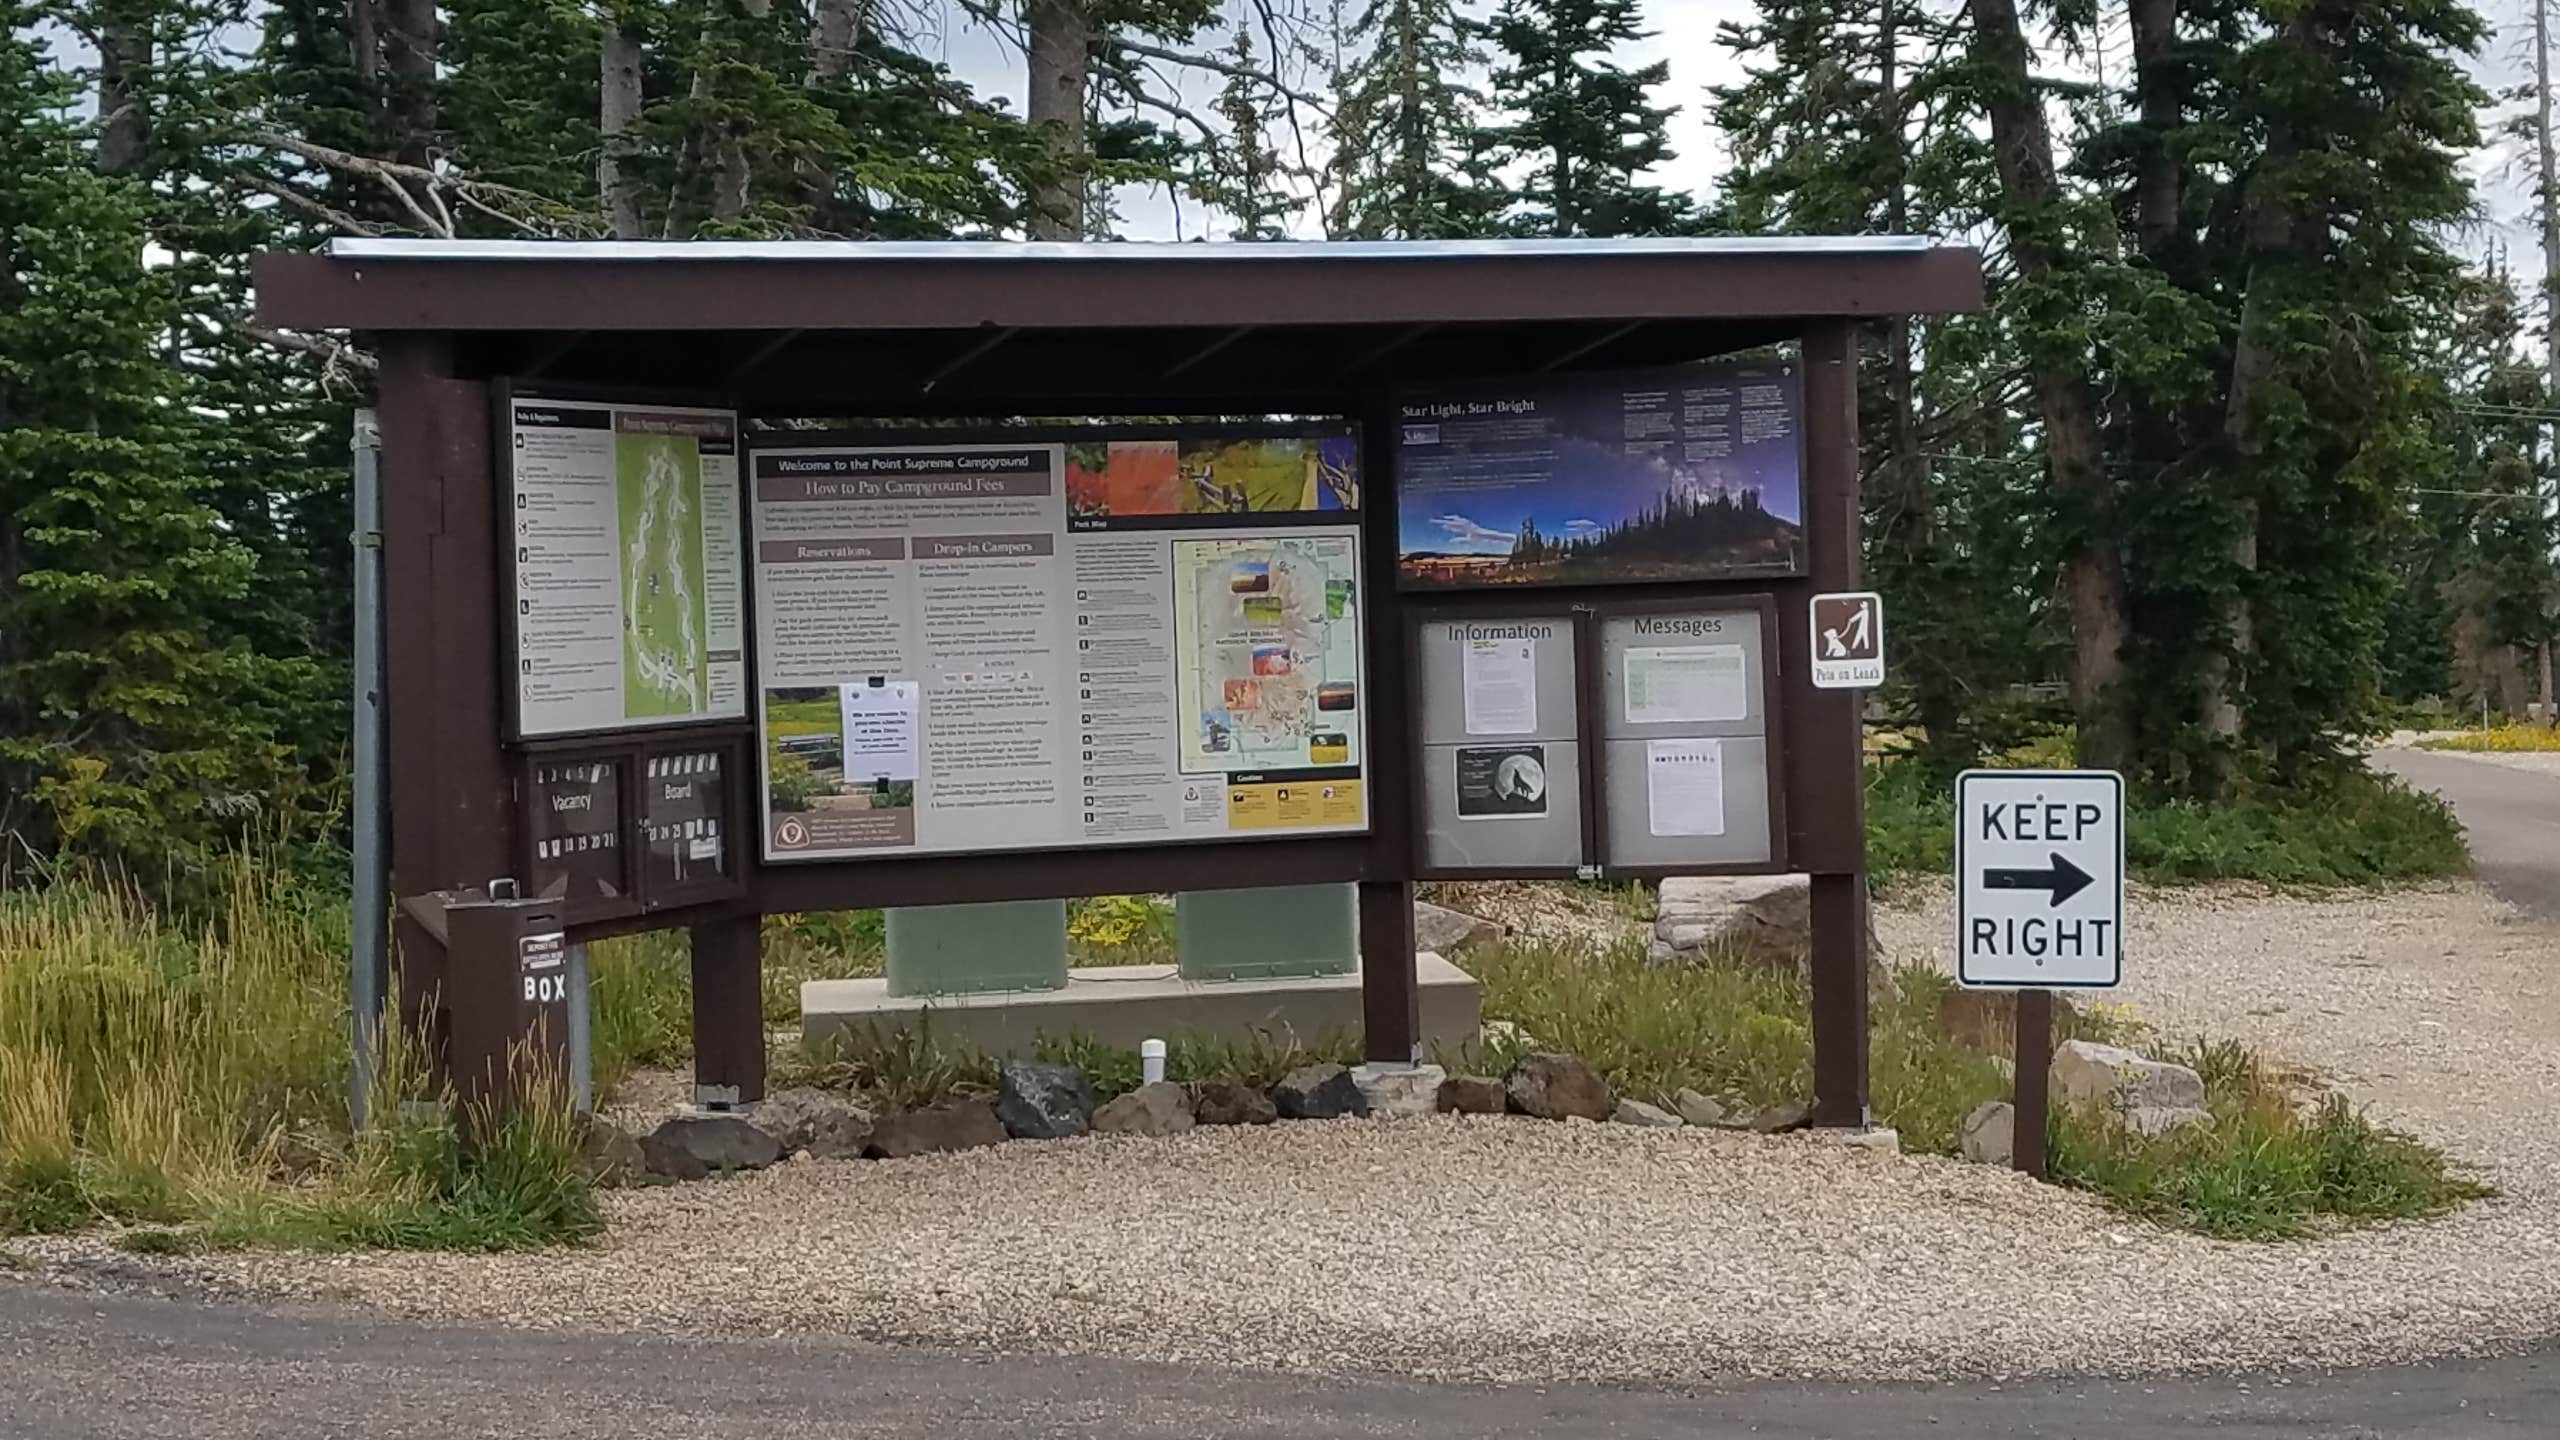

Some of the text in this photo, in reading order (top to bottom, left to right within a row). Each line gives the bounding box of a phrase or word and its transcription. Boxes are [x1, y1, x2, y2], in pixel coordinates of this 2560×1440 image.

[1402, 399, 1536, 418] Star Light, Star Bright
[779, 456, 1029, 472] Welcome to the Point Supreme Campground
[805, 478, 1005, 497] How to Pay Campground Fees
[797, 545, 872, 558] Reservations
[933, 541, 1034, 556] Drop-in Campers
[1448, 624, 1553, 641] Information
[1634, 617, 1723, 637] Messages
[665, 779, 692, 800] Board
[552, 794, 592, 812] Vacancy
[1983, 803, 2102, 841] KEEP
[1972, 918, 2112, 957] RIGHT
[524, 973, 566, 1002] BOX
